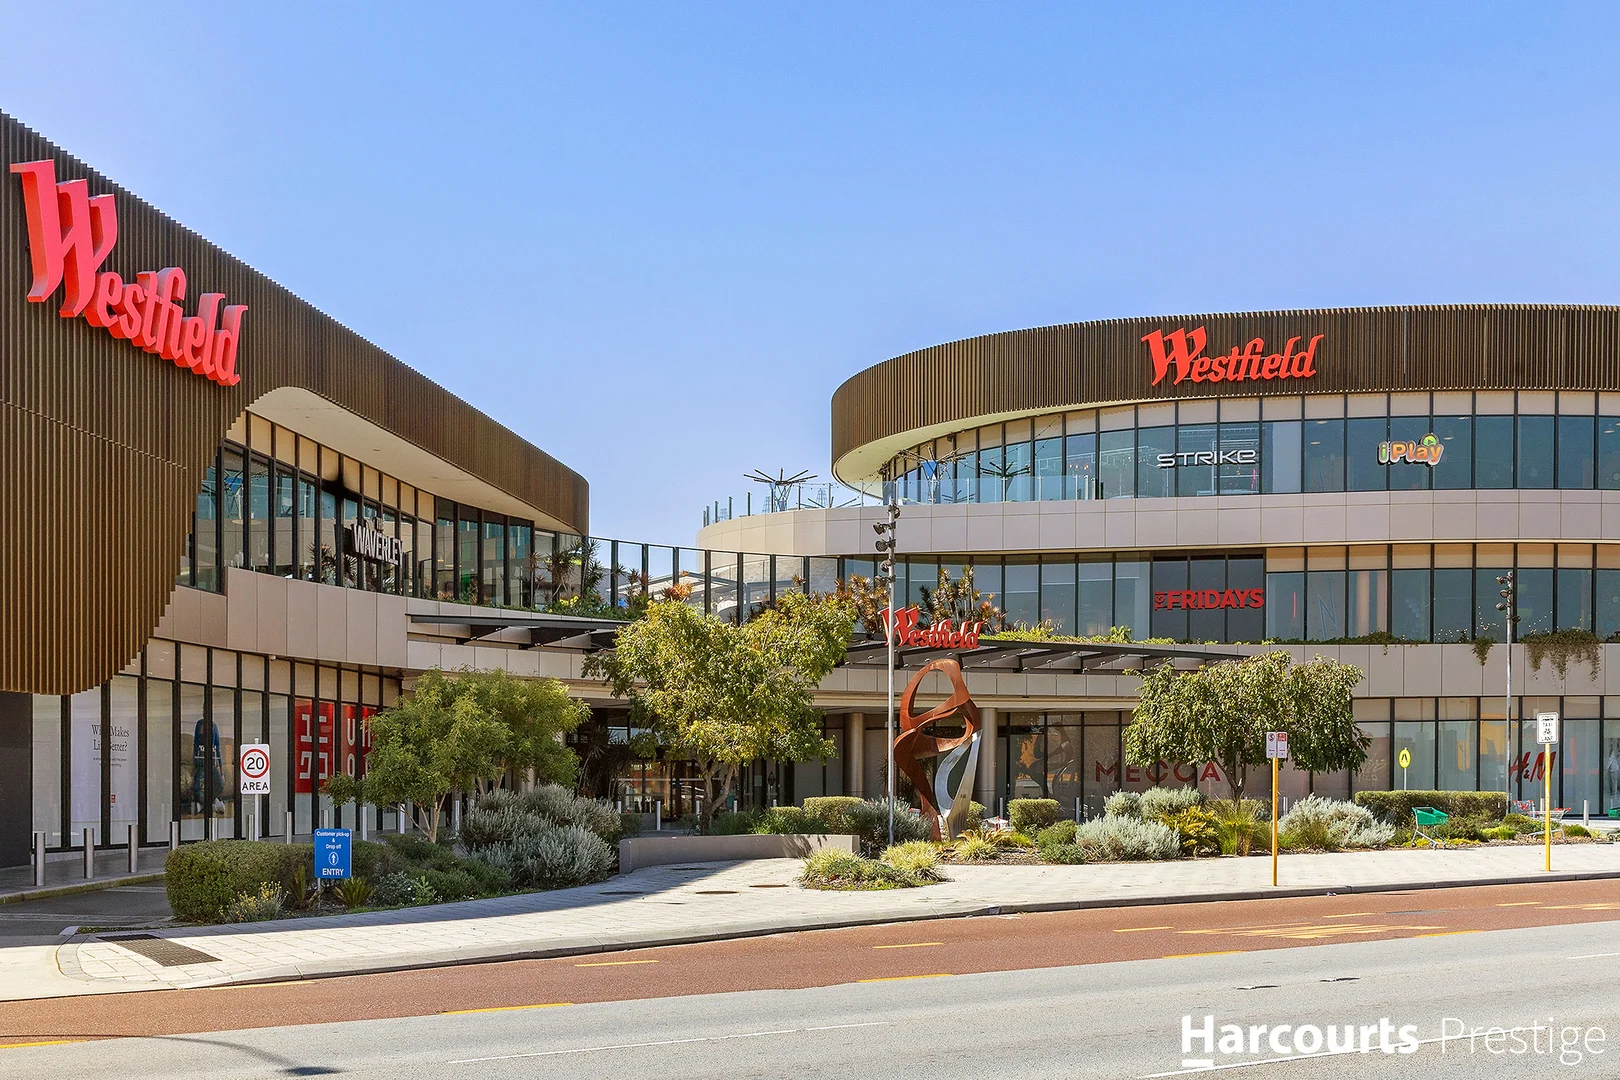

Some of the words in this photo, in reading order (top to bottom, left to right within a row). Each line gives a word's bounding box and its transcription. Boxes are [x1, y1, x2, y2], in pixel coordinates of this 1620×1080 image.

[10, 159, 248, 386] Westfield
[1141, 325, 1325, 387] Westfield
[353, 523, 403, 568] WAVERLEY
[1167, 588, 1265, 610] FRIDAYS
[877, 606, 984, 649] Westfield
[246, 756, 265, 770] 20
[1095, 759, 1221, 783] MECCA
[242, 781, 269, 791] AREA
[322, 868, 344, 876] ENTRY
